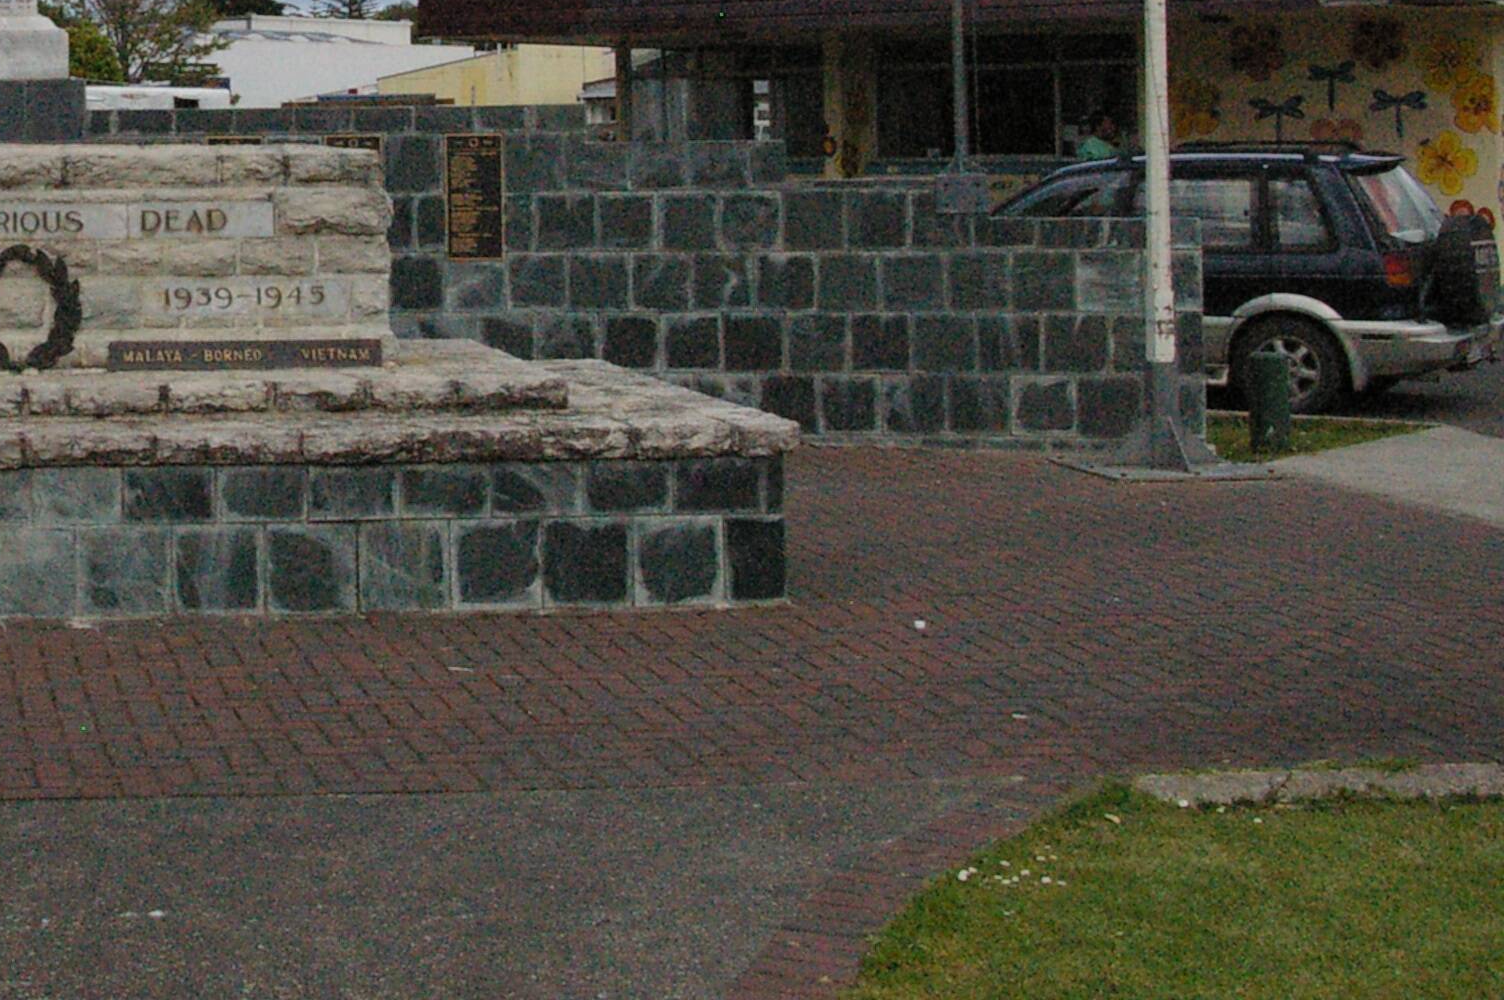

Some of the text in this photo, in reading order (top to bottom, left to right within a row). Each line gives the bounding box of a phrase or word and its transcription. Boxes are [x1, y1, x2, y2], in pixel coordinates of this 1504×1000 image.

[141, 209, 228, 233] DEAD
[123, 348, 183, 363] MALAYA
[203, 347, 263, 362] BORNEO
[300, 347, 370, 362] VIETNAM
